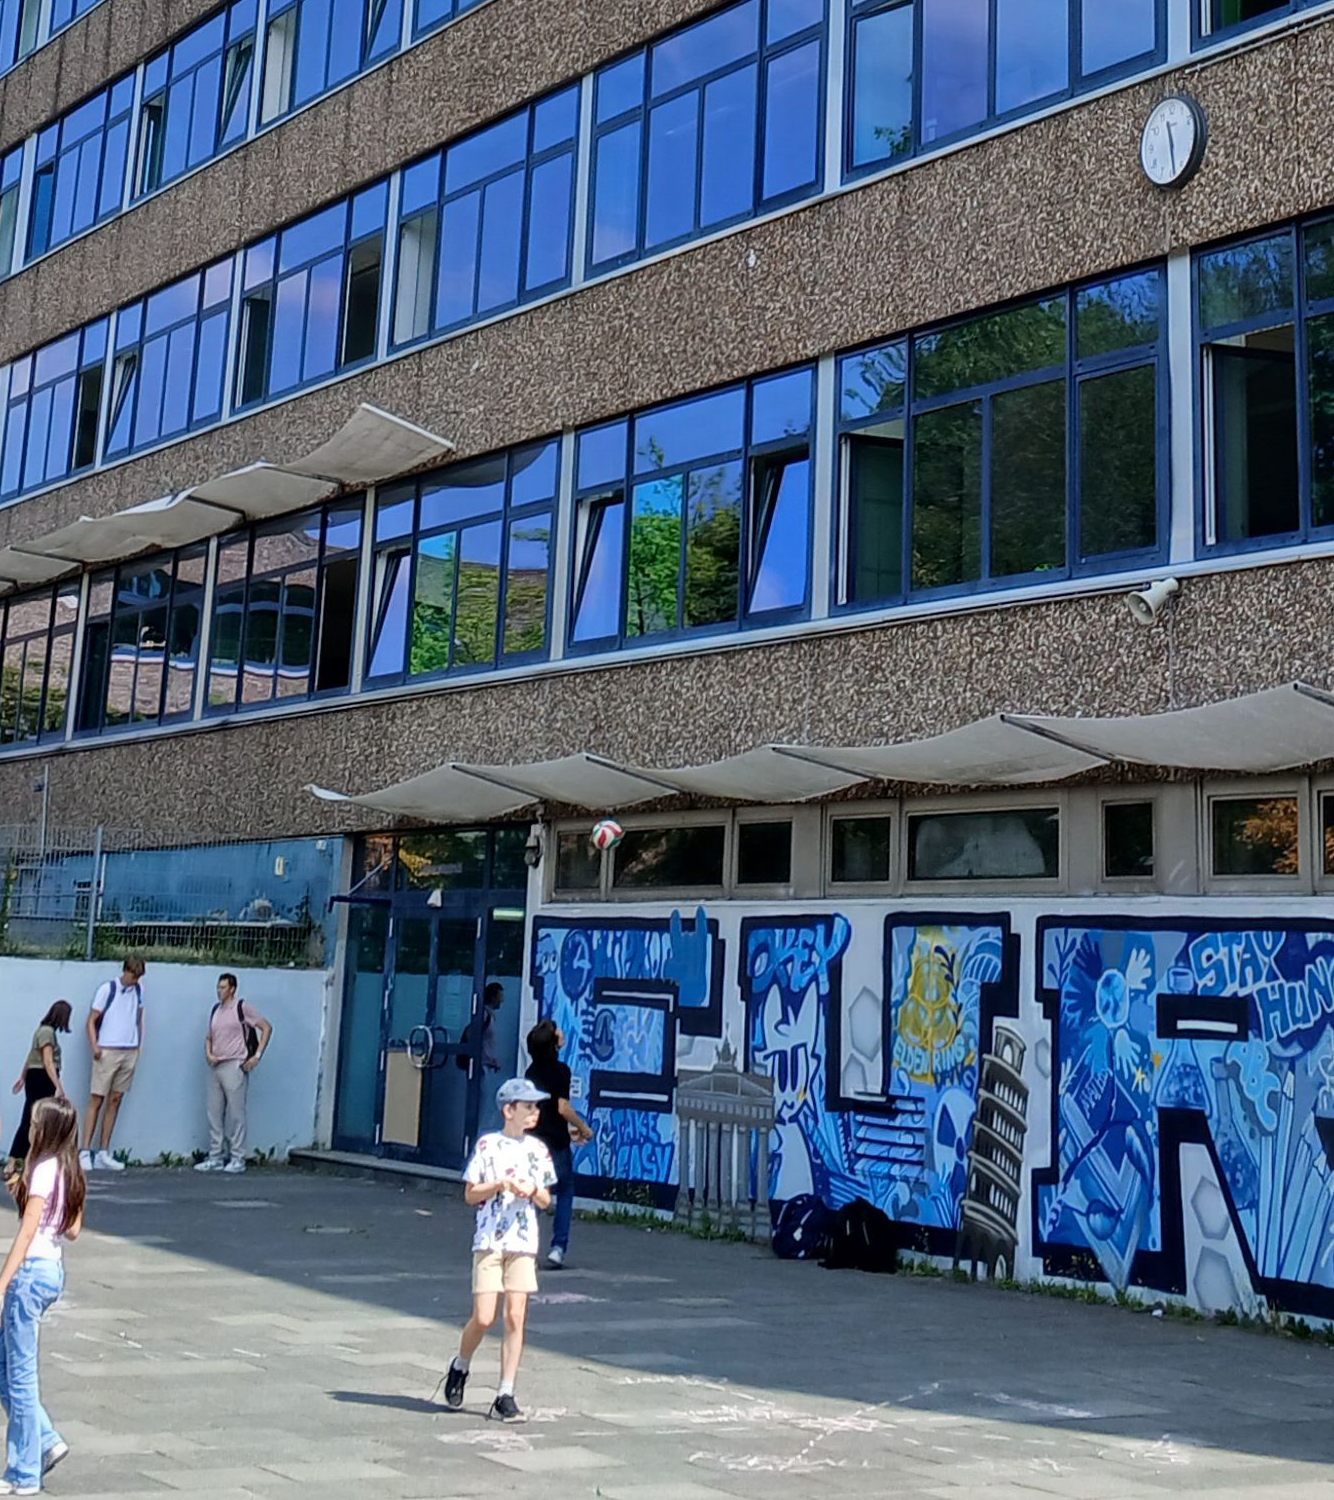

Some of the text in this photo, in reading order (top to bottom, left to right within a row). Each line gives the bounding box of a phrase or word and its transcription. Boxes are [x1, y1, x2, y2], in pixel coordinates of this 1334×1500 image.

[747, 913, 851, 996] OKEY
[1189, 931, 1285, 998] STAY
[613, 1108, 659, 1150] TAKE
[617, 1143, 674, 1183] EASY
